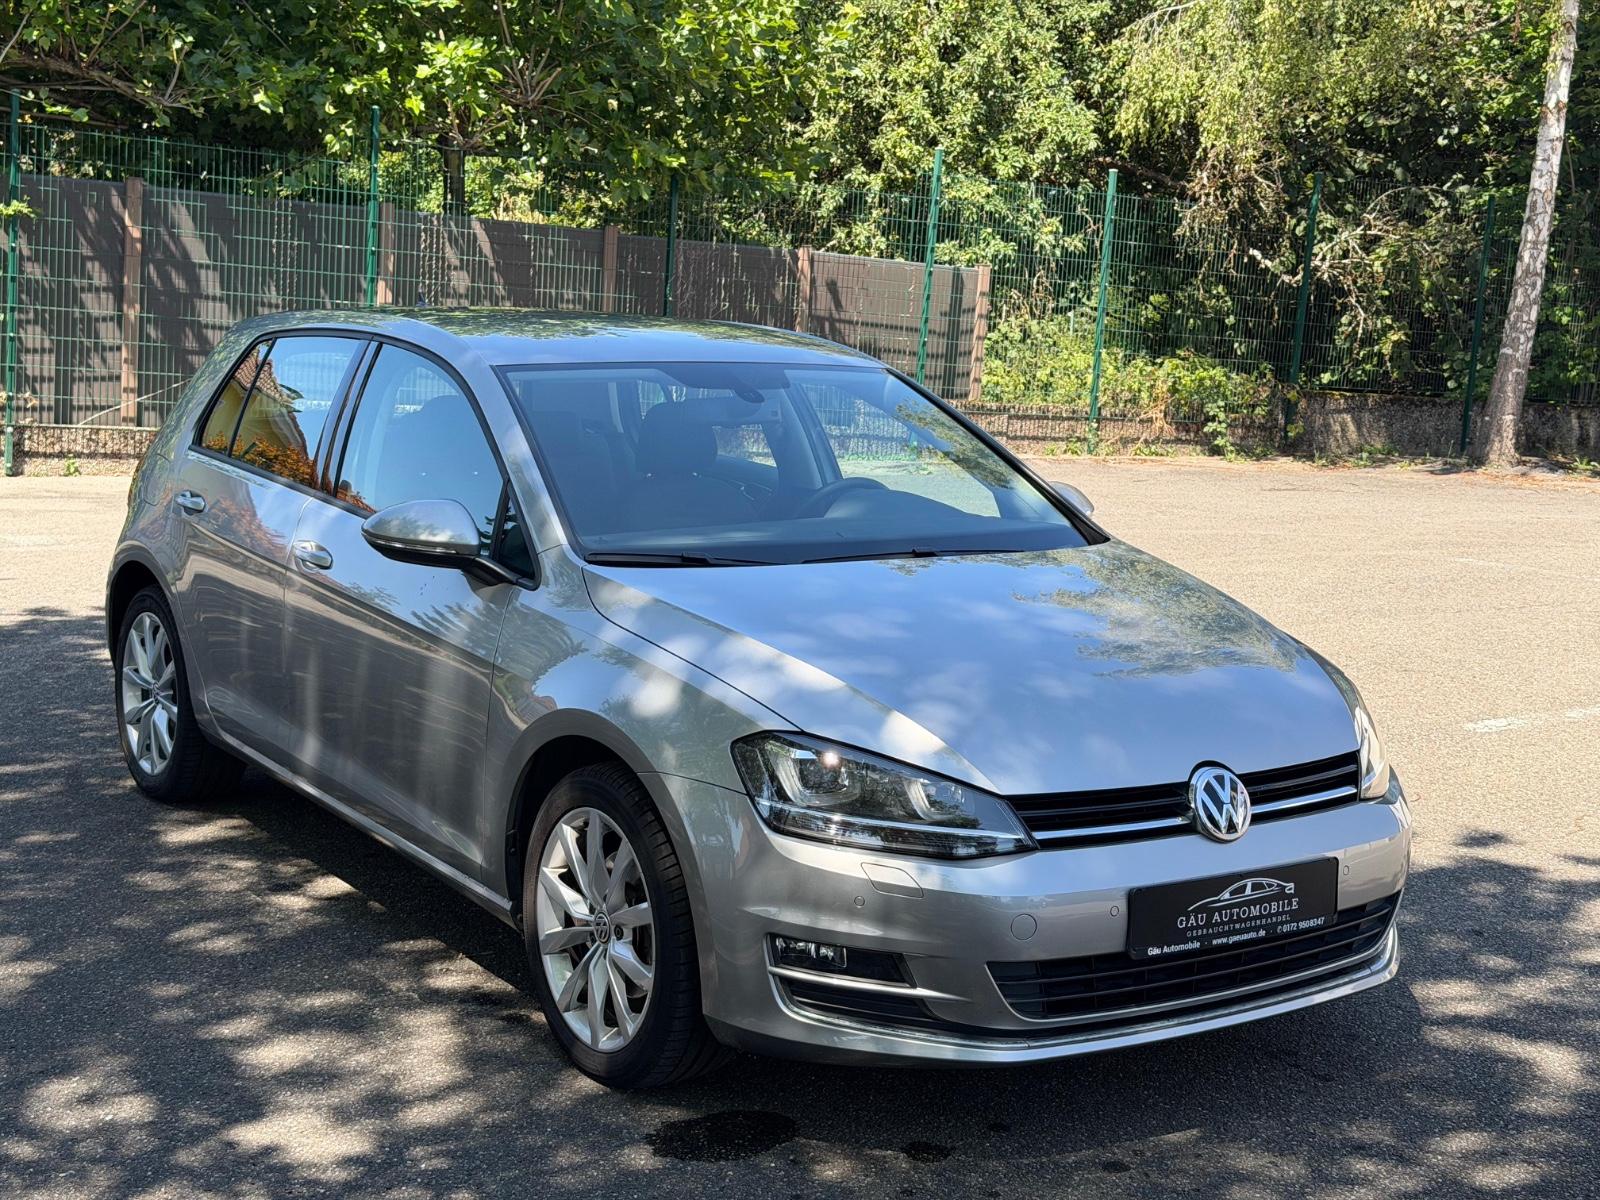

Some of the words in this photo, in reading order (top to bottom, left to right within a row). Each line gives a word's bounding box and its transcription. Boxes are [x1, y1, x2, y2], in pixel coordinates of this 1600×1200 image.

[1194, 768, 1250, 840] VW
[1177, 913, 1207, 929] GÄU
[1212, 898, 1299, 924] AUTOMOBILE
[1186, 914, 1291, 938] GEBRAUCHTWAGENHANDEL
[1147, 946, 1162, 956] Gäu
[1162, 941, 1201, 954] Automobile
[1212, 928, 1266, 945] www.gaeuauto.de
[1283, 922, 1298, 933] 0172
